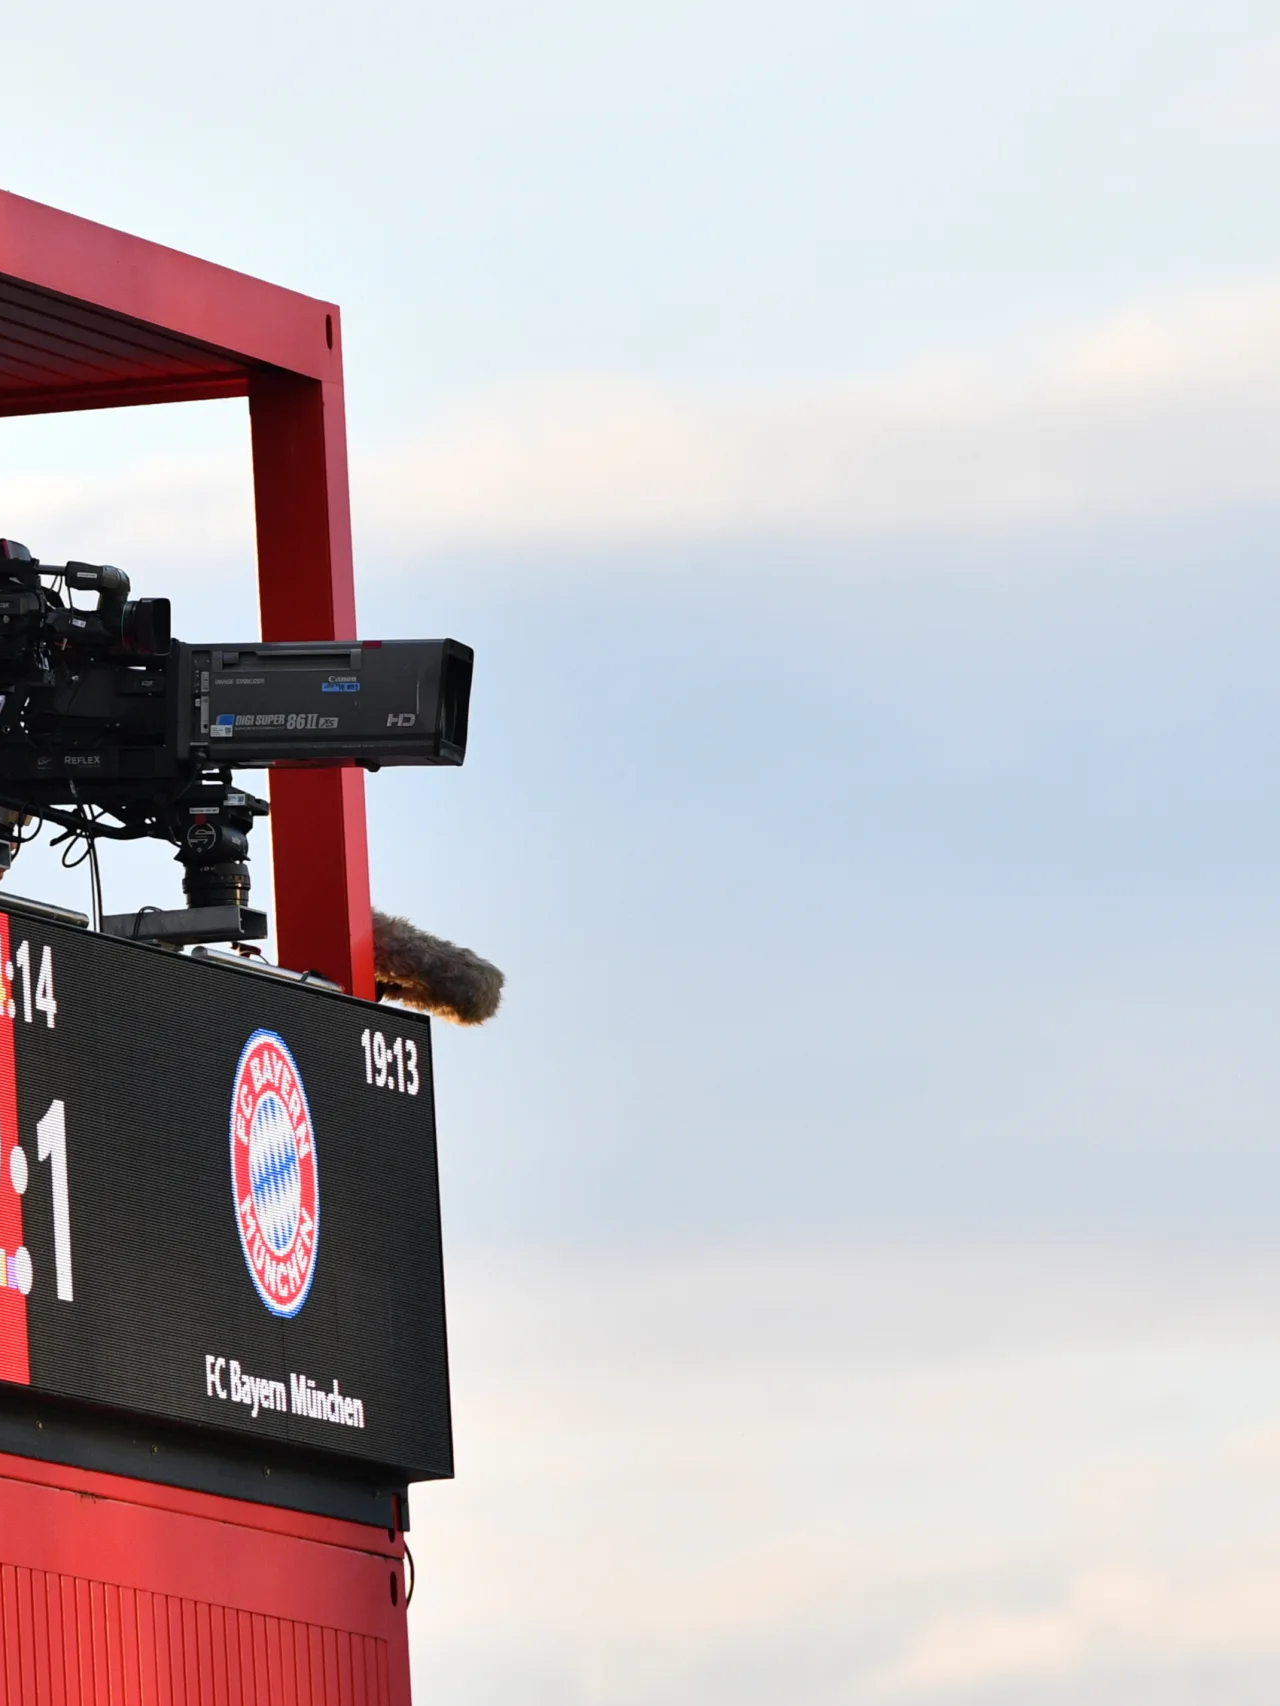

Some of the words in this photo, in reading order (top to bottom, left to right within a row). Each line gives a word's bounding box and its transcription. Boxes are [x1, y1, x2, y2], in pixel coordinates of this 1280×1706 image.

[328, 675, 357, 683] Canon
[235, 714, 255, 726] DIGI
[255, 714, 286, 725] SUPER
[385, 713, 417, 727] HD
[361, 1028, 420, 1096] 19:13
[250, 1050, 311, 1159] BAYERN
[205, 1354, 228, 1400] FC
[229, 1359, 287, 1418] Bayern
[289, 1372, 365, 1429] München
